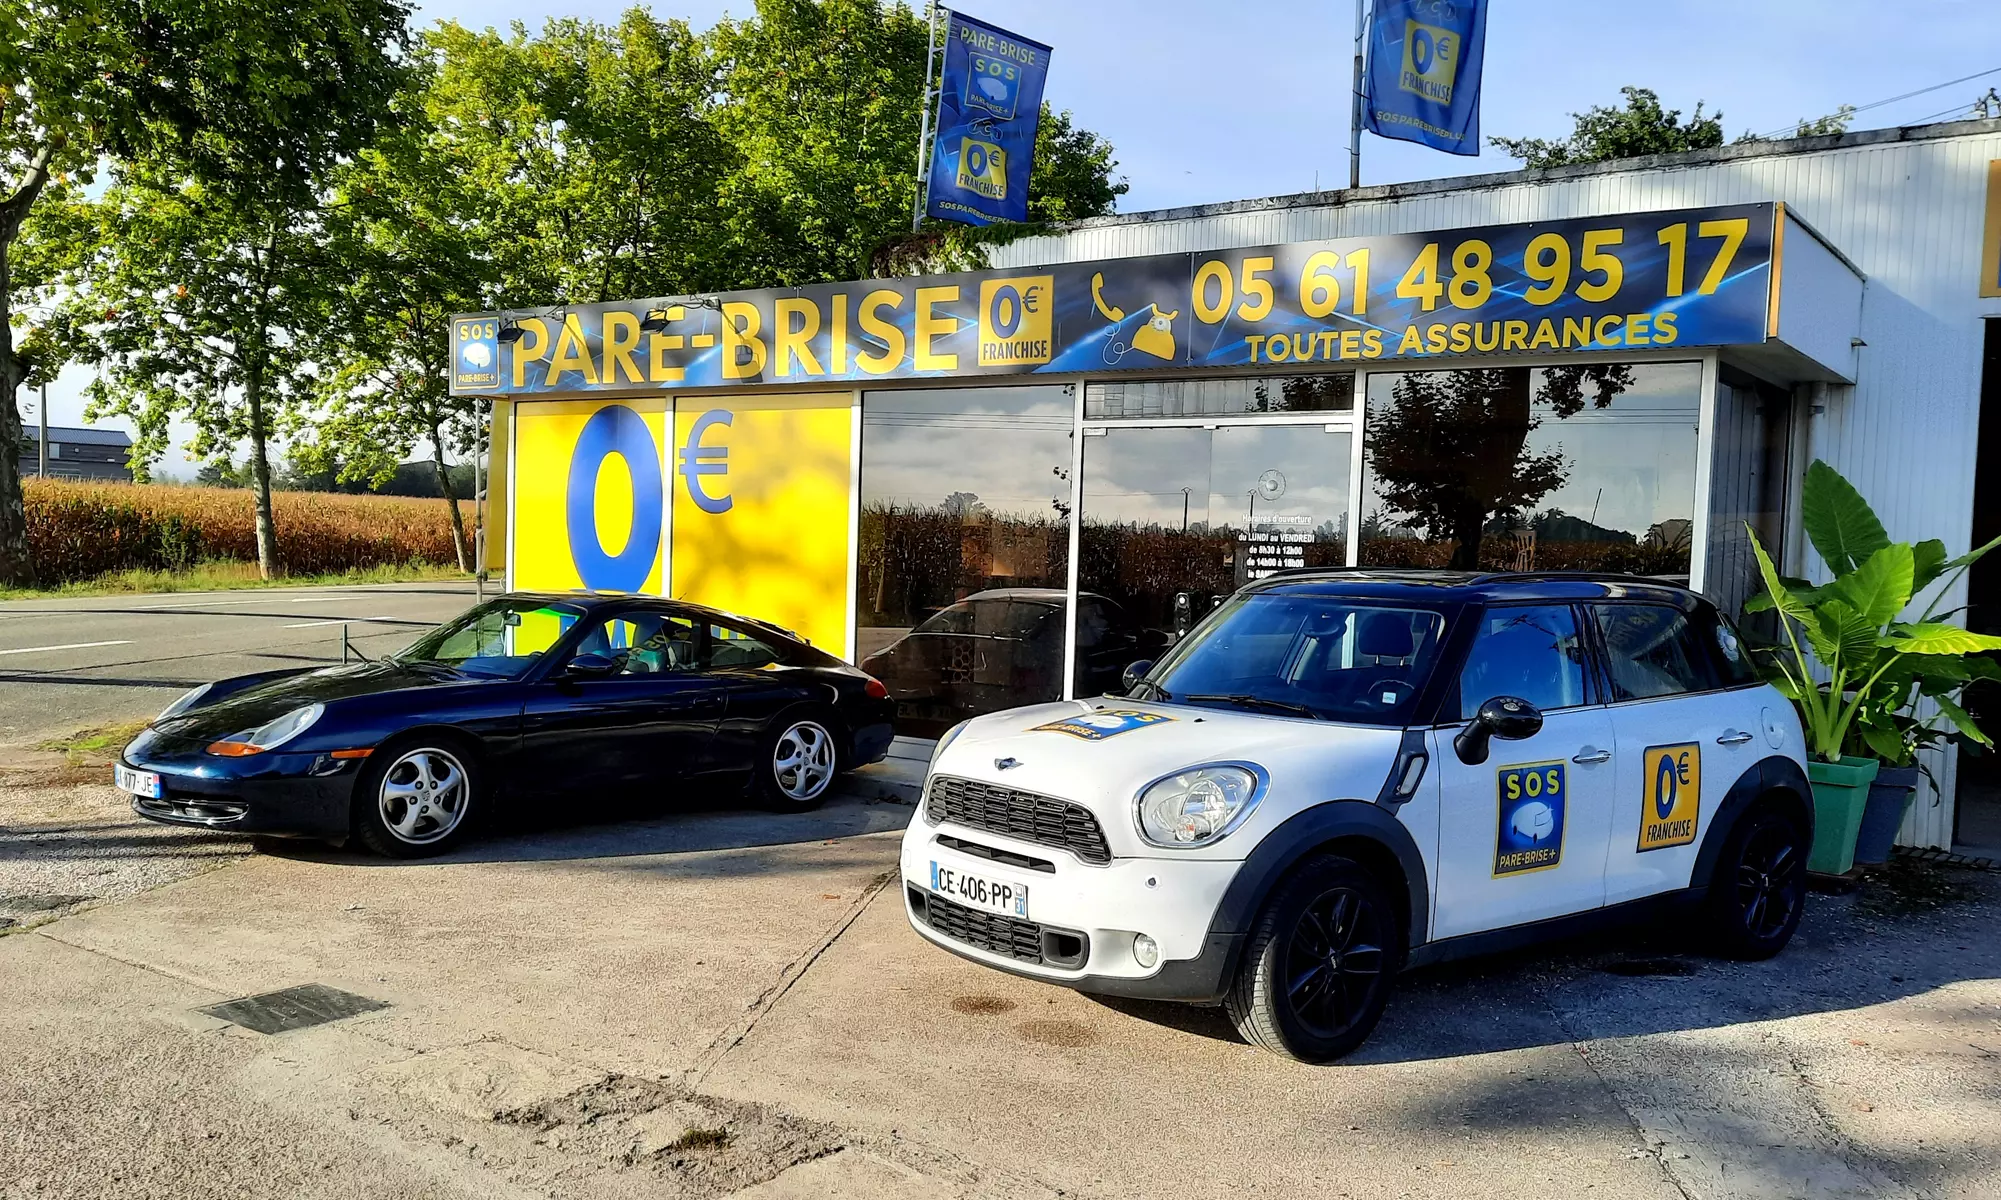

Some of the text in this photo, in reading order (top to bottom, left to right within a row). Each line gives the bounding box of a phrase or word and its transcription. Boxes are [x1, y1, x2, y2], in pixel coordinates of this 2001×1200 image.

[960, 27, 1036, 65] PARE-BRISE
[1411, 28, 1450, 75] 0€
[974, 59, 1015, 79] SOS
[1402, 71, 1451, 102] FRANCHISE
[967, 144, 1000, 178] 0€
[959, 173, 1004, 196] FRANCHISE
[1191, 217, 1748, 325] 05 61 48 95 17
[459, 322, 495, 342] SOS
[512, 286, 960, 387] PARE-BRISE
[1245, 312, 1678, 363] TOUTES ASSURANCES
[983, 340, 1047, 361] FRANCHISE
[1238, 533, 1315, 543] du LUNDI au VENDREDI
[1249, 545, 1258, 554] de
[1259, 545, 1275, 555] 8h30
[1282, 546, 1303, 555] 12h00
[1246, 558, 1255, 566] de
[1256, 558, 1277, 567] 14h00
[1506, 769, 1560, 800] SOS
[1655, 751, 1690, 820] 0€
[1646, 819, 1692, 842] FRANCHISE
[938, 867, 1012, 909] CE-406-PP
